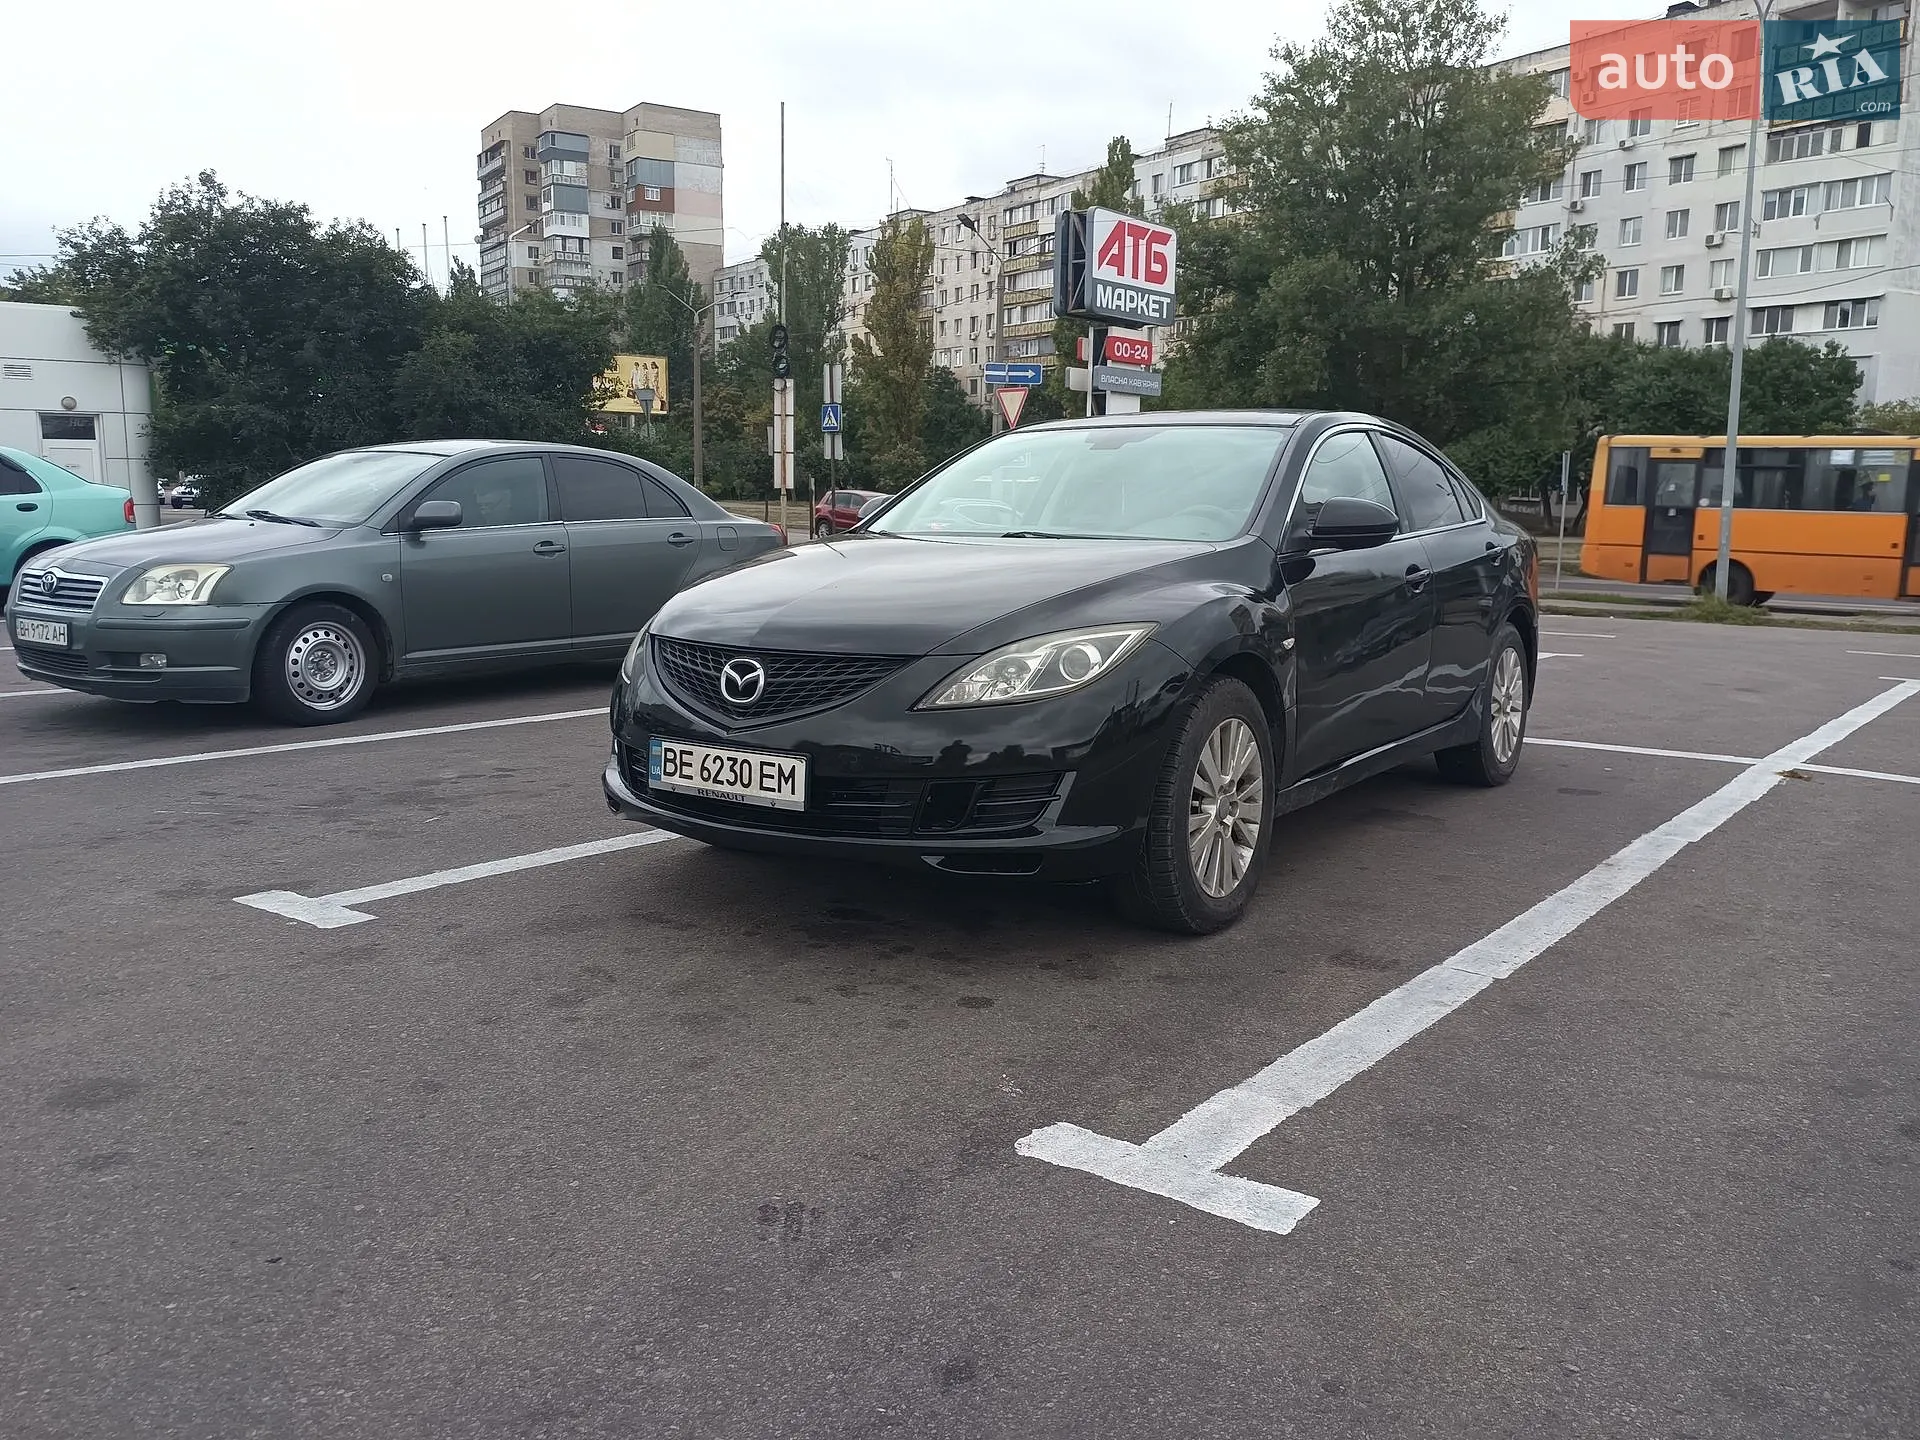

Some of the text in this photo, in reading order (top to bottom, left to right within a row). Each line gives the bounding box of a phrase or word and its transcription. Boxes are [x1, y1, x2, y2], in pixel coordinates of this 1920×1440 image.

[1097, 219, 1173, 286] АТБ
[1096, 283, 1171, 319] МАРКЕТ
[1114, 341, 1149, 360] 00-24
[1100, 374, 1128, 385] ВЛАСНА
[52, 625, 66, 643] AH
[651, 765, 661, 776] UA
[663, 747, 796, 796] BE 6230 EM
[697, 788, 746, 803] RENAULT
